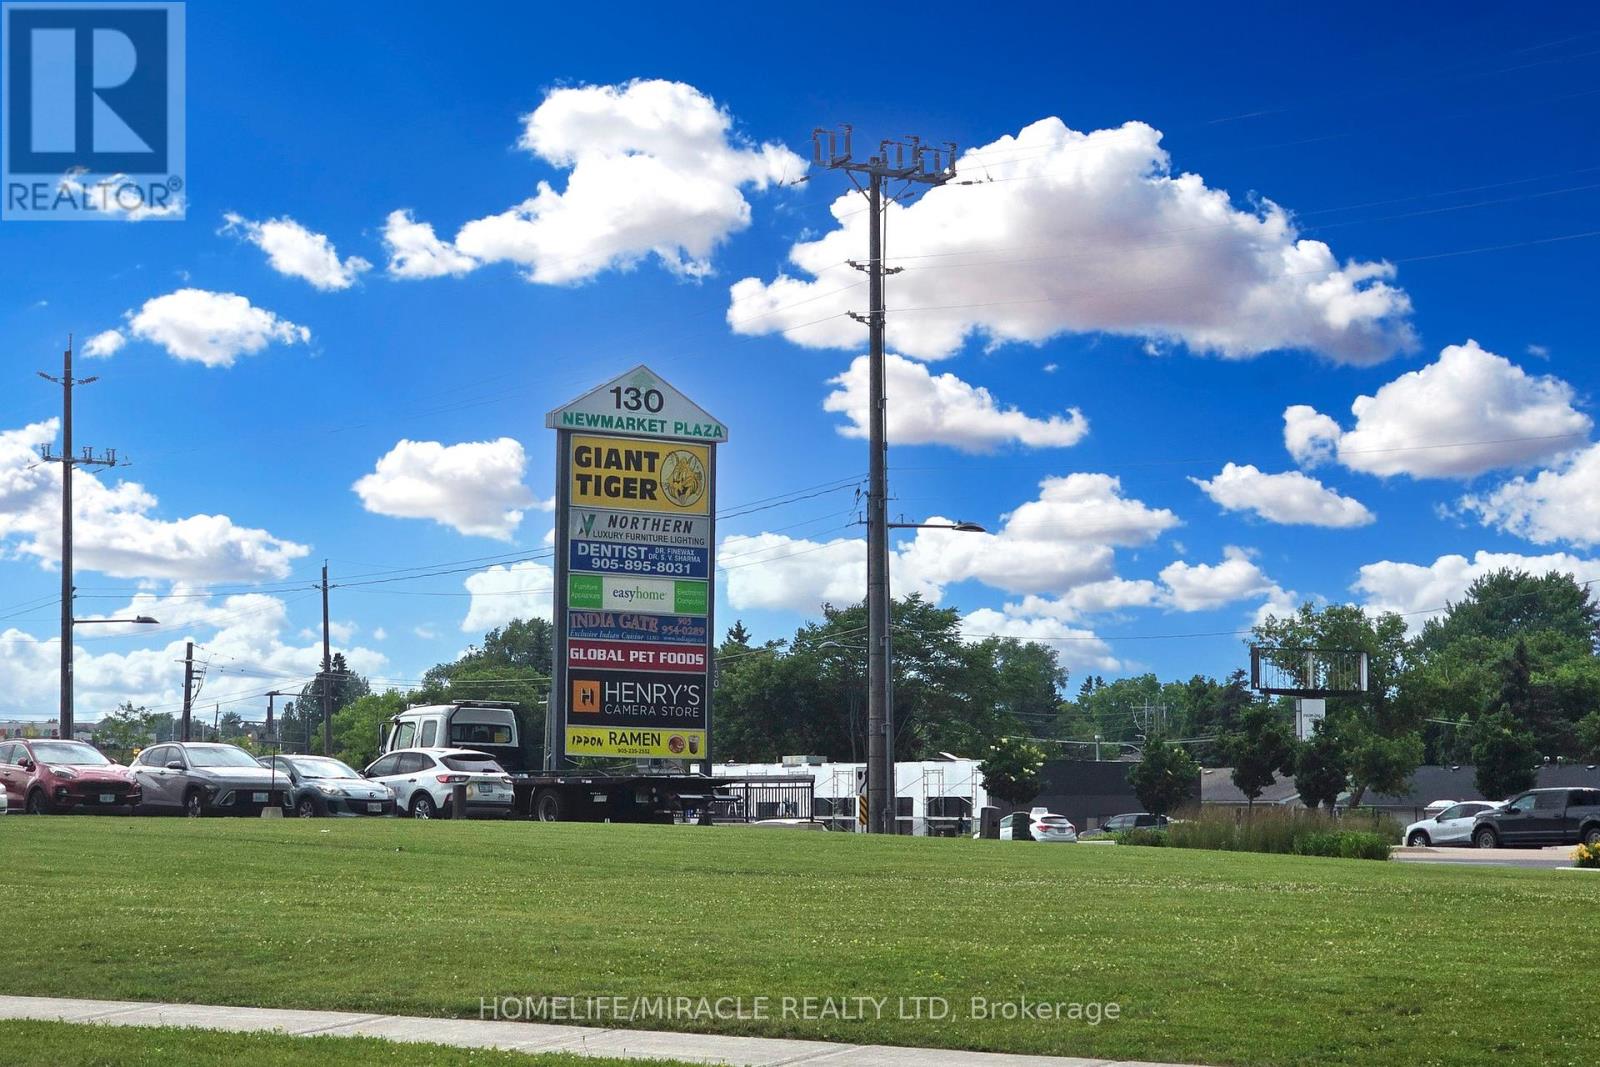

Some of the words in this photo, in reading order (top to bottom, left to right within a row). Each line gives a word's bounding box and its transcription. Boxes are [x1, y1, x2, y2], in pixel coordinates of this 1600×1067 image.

[609, 386, 664, 413] 130
[562, 412, 667, 433] NEWMARKET
[674, 421, 723, 438] PLAZA
[574, 445, 660, 473] GIANT
[575, 473, 658, 501] TIGER
[608, 515, 693, 534] NORTHERN
[593, 530, 624, 540] LUXURY
[625, 532, 668, 543] FURNITURE
[670, 536, 705, 546] LIGHTING
[577, 543, 648, 560] DENTIST
[591, 558, 691, 574] 905-895-8031
[612, 586, 665, 603] easyhome
[570, 611, 616, 629] INDIA
[618, 613, 658, 633] GATE
[599, 630, 620, 640] Indian
[569, 647, 625, 662] GLOBAL
[629, 650, 655, 664] PET
[659, 652, 704, 665] FOODS
[604, 681, 700, 706] HENRY'S
[604, 704, 657, 717] CAMERA
[661, 706, 700, 718] STORE
[608, 731, 661, 747] RAMEN
